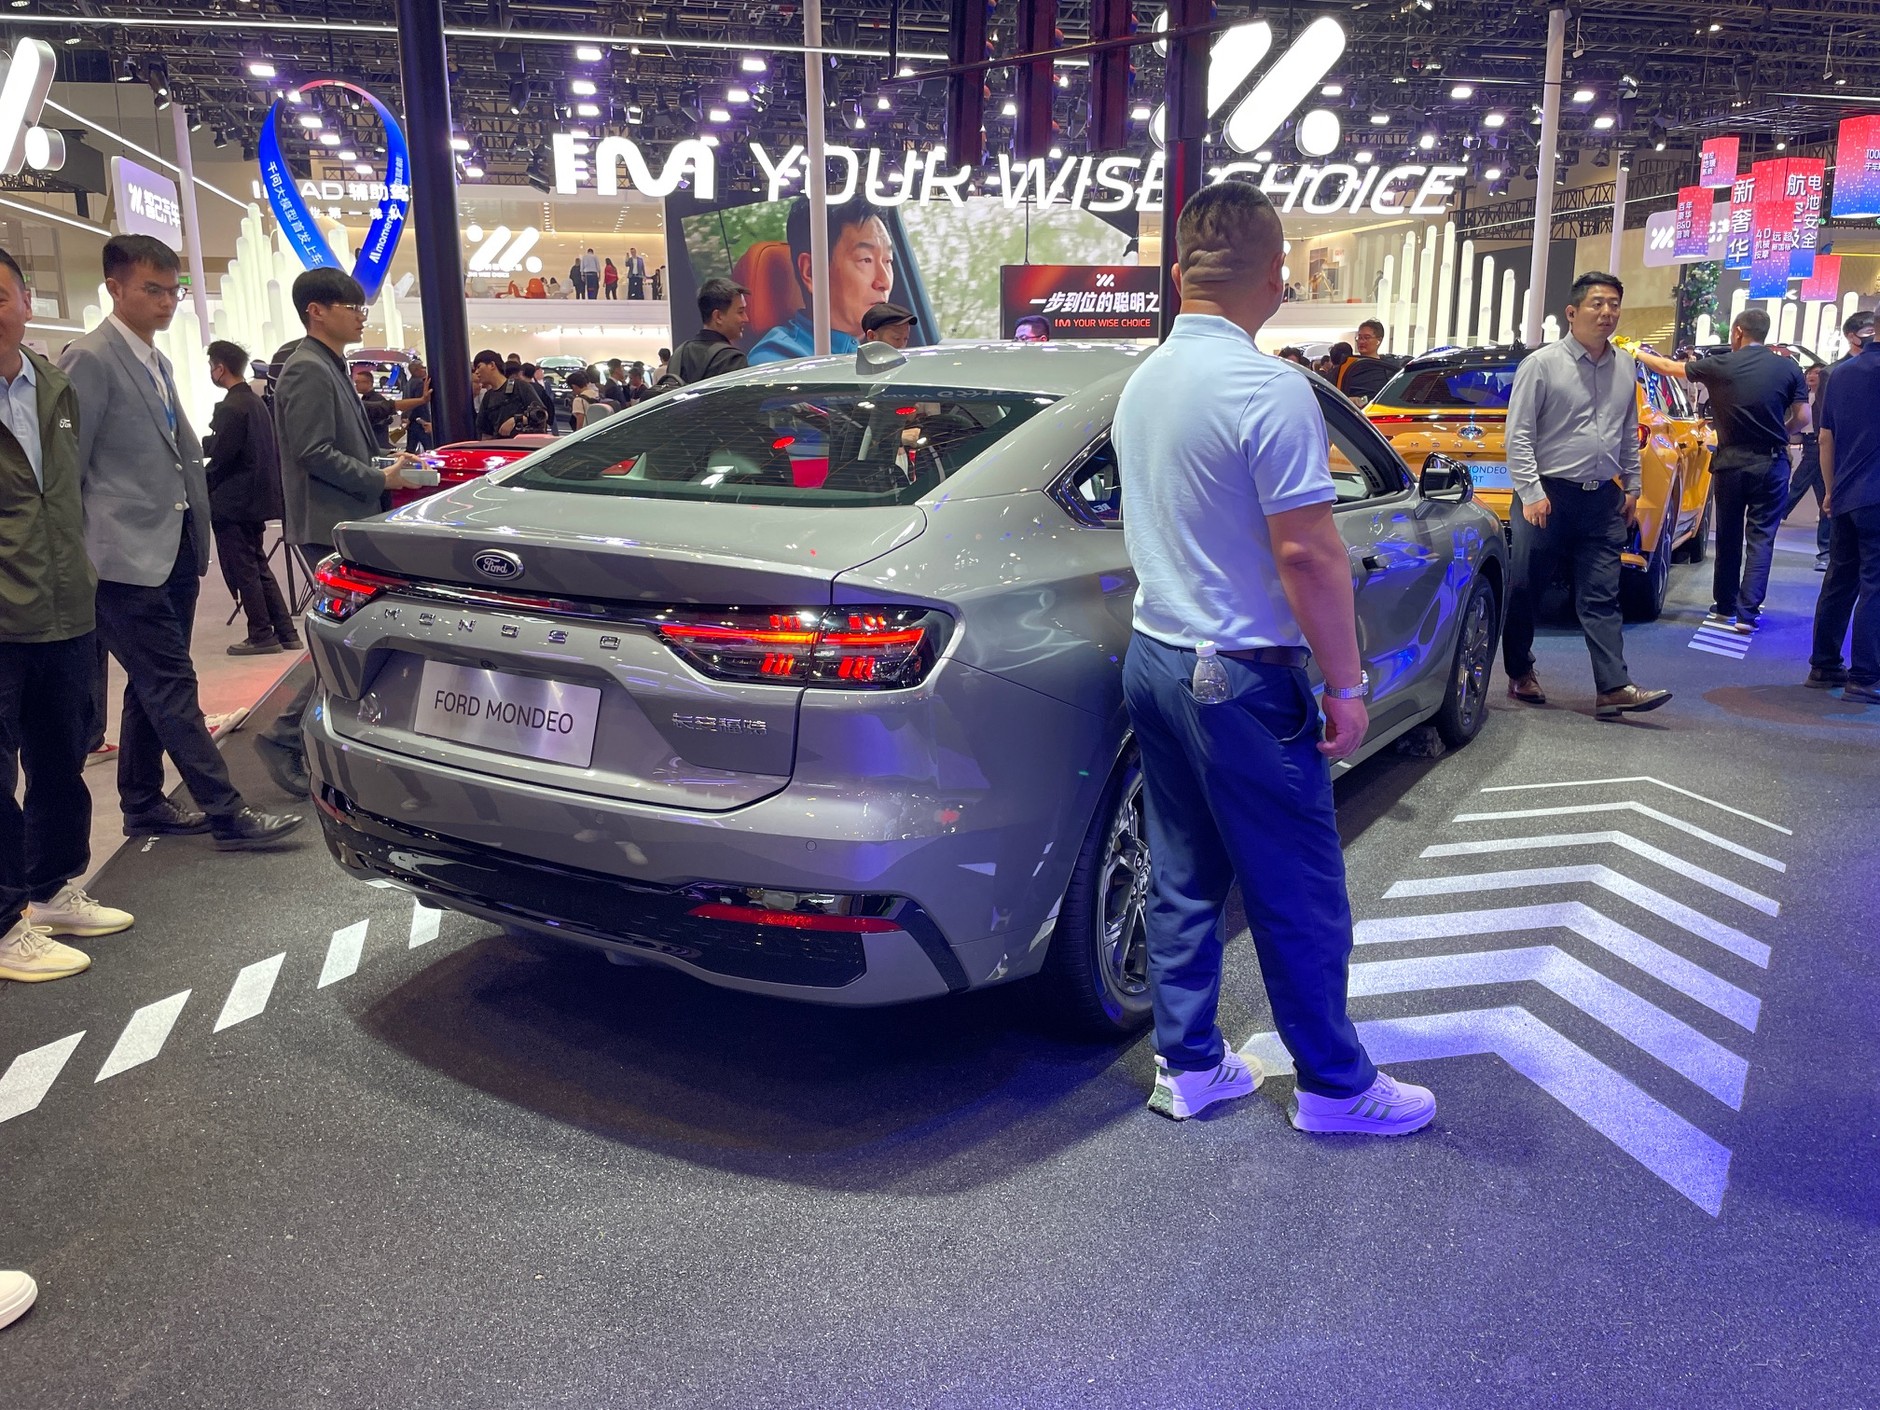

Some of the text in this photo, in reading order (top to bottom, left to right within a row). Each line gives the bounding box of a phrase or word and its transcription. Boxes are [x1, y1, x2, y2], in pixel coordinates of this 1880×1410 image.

[300, 182, 344, 200] AD
[348, 183, 413, 202] 辅助驾
[749, 143, 971, 207] YOUR
[998, 152, 1165, 211] WISE
[267, 161, 324, 266] 千问大模型首发上车
[1728, 177, 1756, 263] 新奢华
[1755, 228, 1771, 240] 4D
[1801, 175, 1822, 249] 电池安全
[1029, 291, 1160, 313] 一步到位的聪明之
[1073, 318, 1096, 327] YOUR
[1097, 318, 1119, 327] WISE
[1121, 318, 1151, 327] CHOICE
[482, 557, 508, 574] Ford
[384, 606, 622, 650] MONDEO
[434, 689, 574, 734] FORD MONDEO
